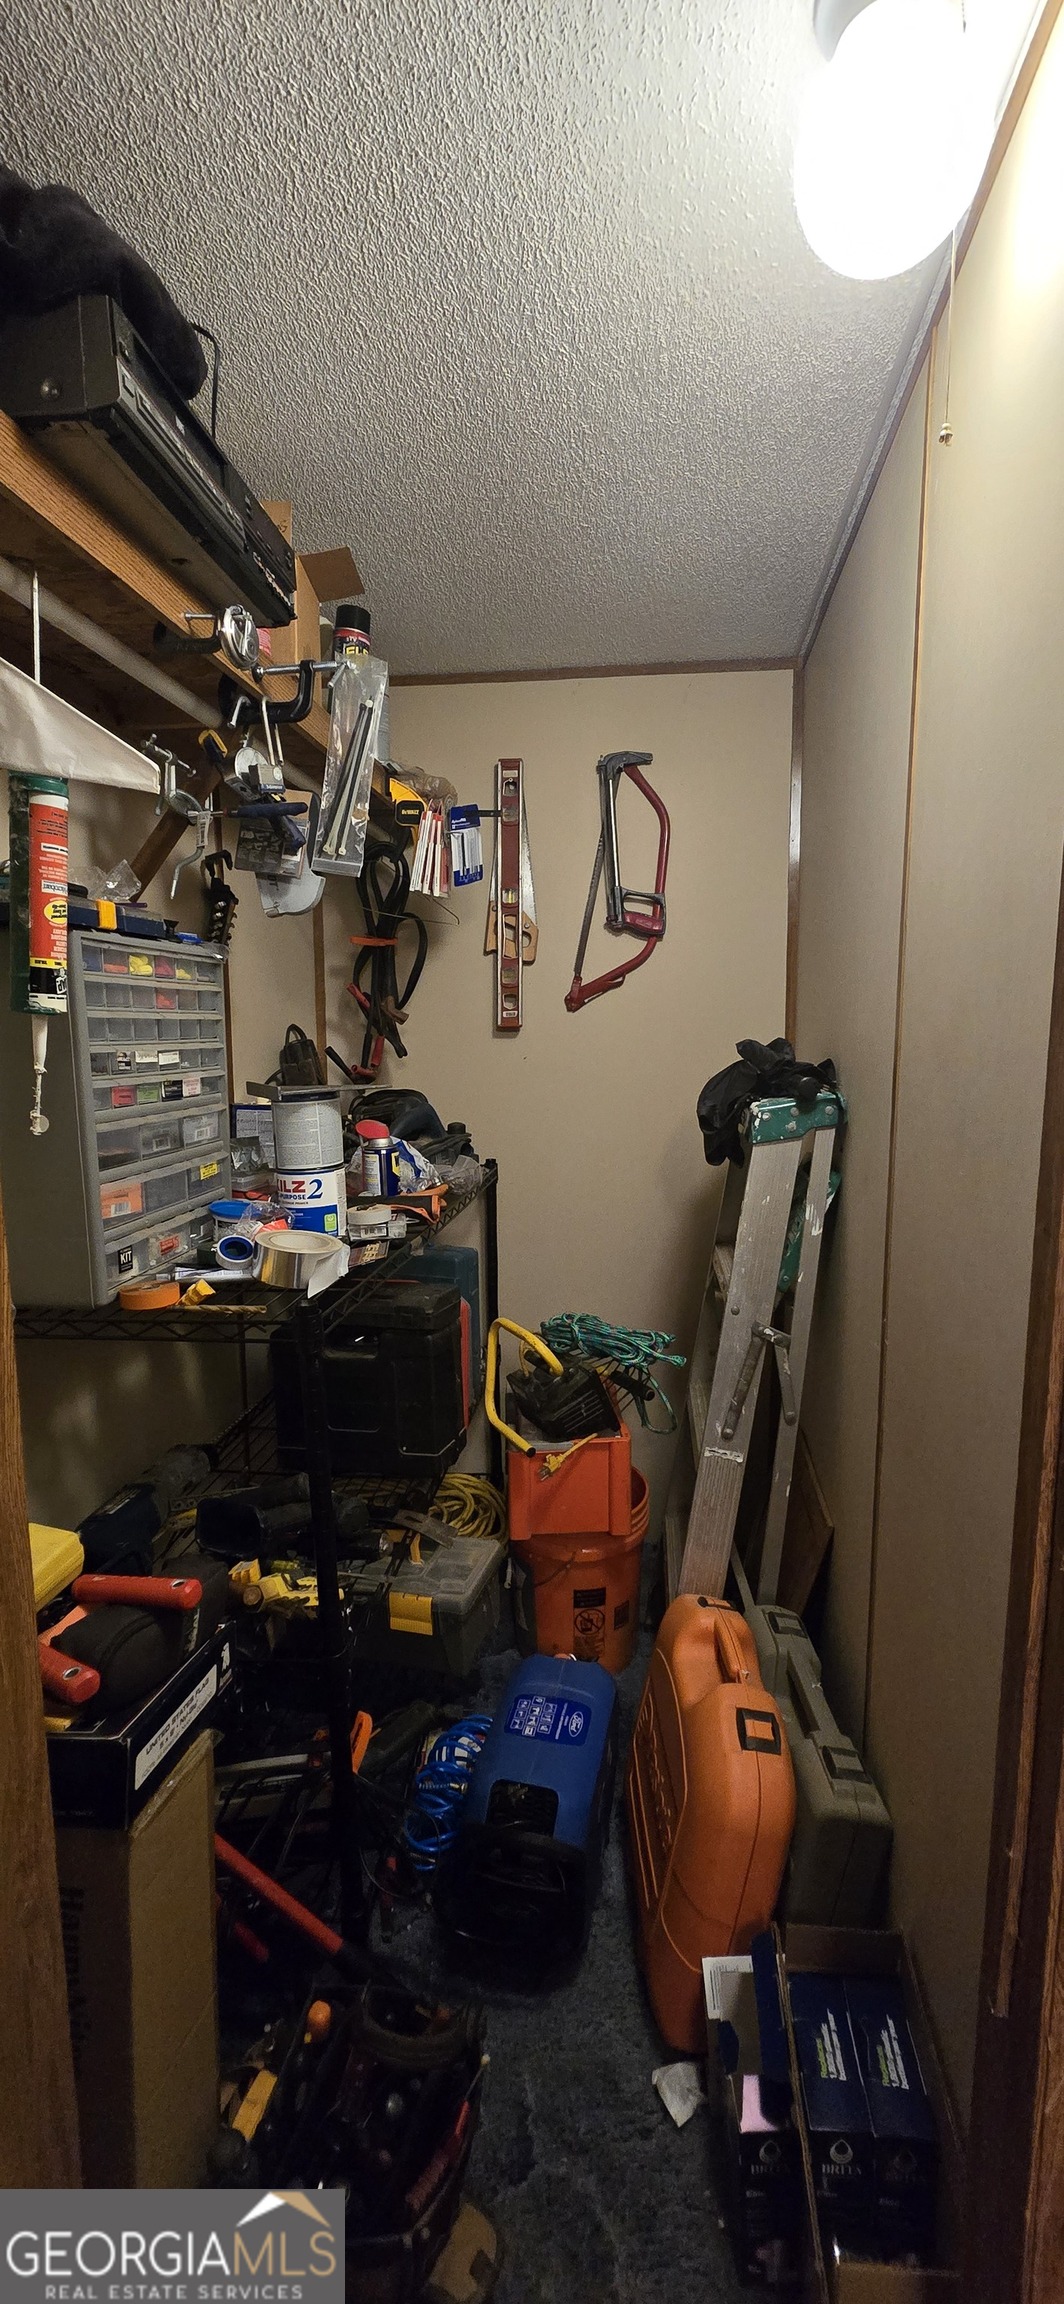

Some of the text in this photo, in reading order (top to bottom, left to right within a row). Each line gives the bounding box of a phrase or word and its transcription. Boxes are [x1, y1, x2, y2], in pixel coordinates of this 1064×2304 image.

[307, 1178, 324, 1200] 2
[119, 1251, 132, 1265] KIT
[822, 2163, 862, 2175] BRITA
